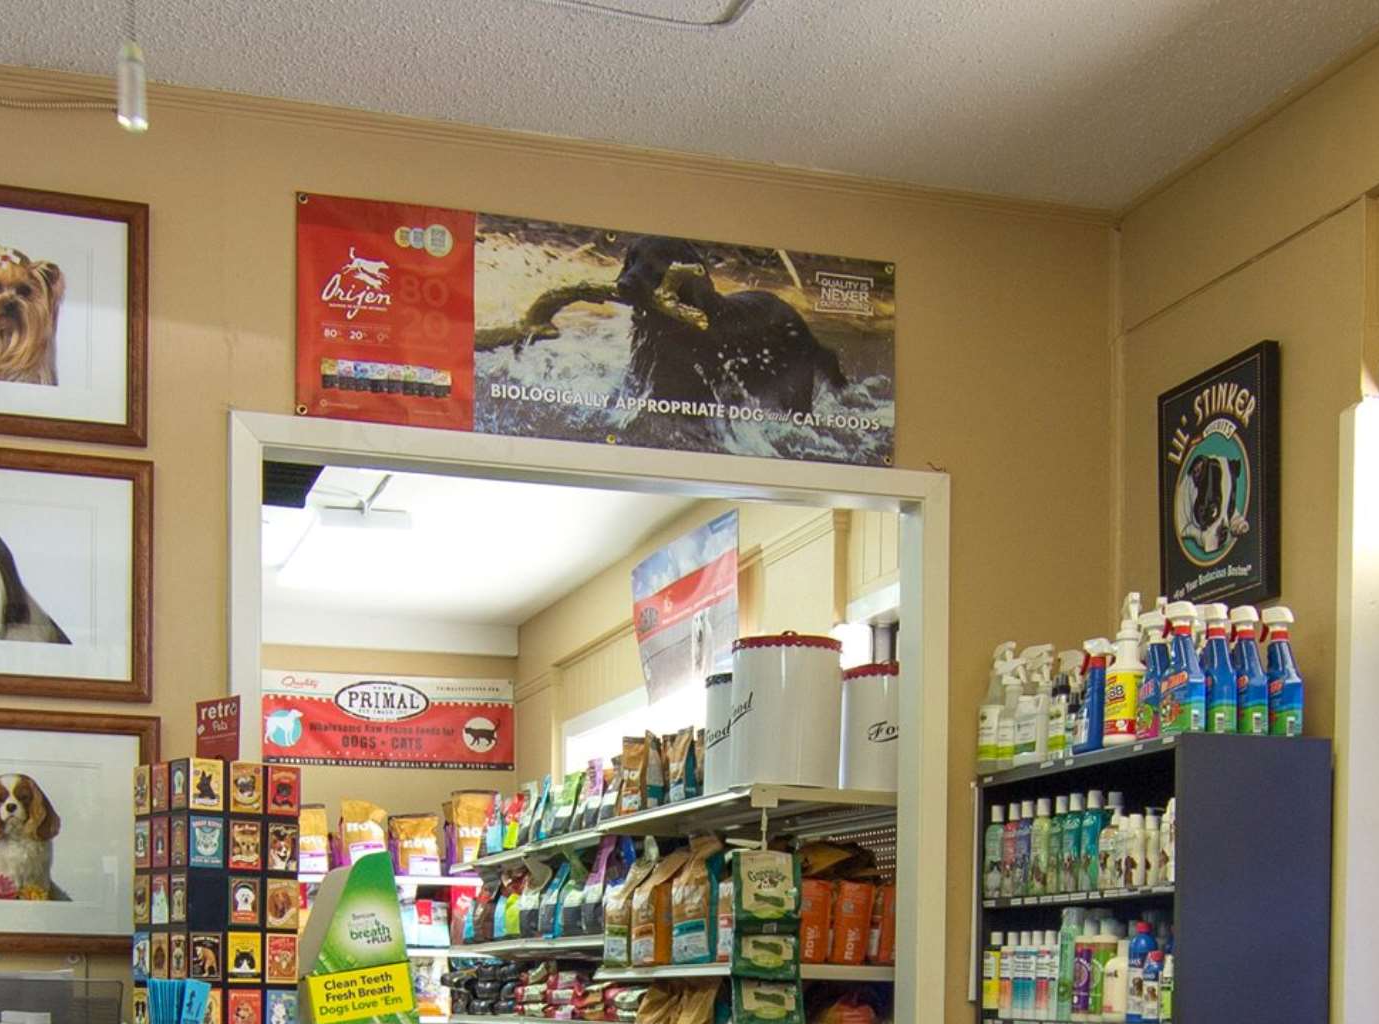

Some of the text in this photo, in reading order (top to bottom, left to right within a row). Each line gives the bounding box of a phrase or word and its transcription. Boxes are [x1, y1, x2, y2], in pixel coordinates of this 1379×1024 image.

[820, 277, 869, 291] QUALITY IS
[321, 273, 392, 320] Orijen
[820, 287, 870, 302] NEVER
[490, 383, 609, 408] BIOLOGICALLY
[615, 397, 725, 420] APPROPRIATE
[729, 405, 764, 423] DOG
[792, 411, 822, 427] CAT
[826, 413, 881, 432] FOODS
[1194, 381, 1256, 430] STINKER
[347, 690, 421, 711] PRIMAL
[341, 734, 424, 751] DOGS CATS
[323, 972, 393, 992] Clean Teeth
[325, 984, 395, 1003] Fresh Breath
[319, 1005, 350, 1017] Dogs
[352, 999, 380, 1011] Love
